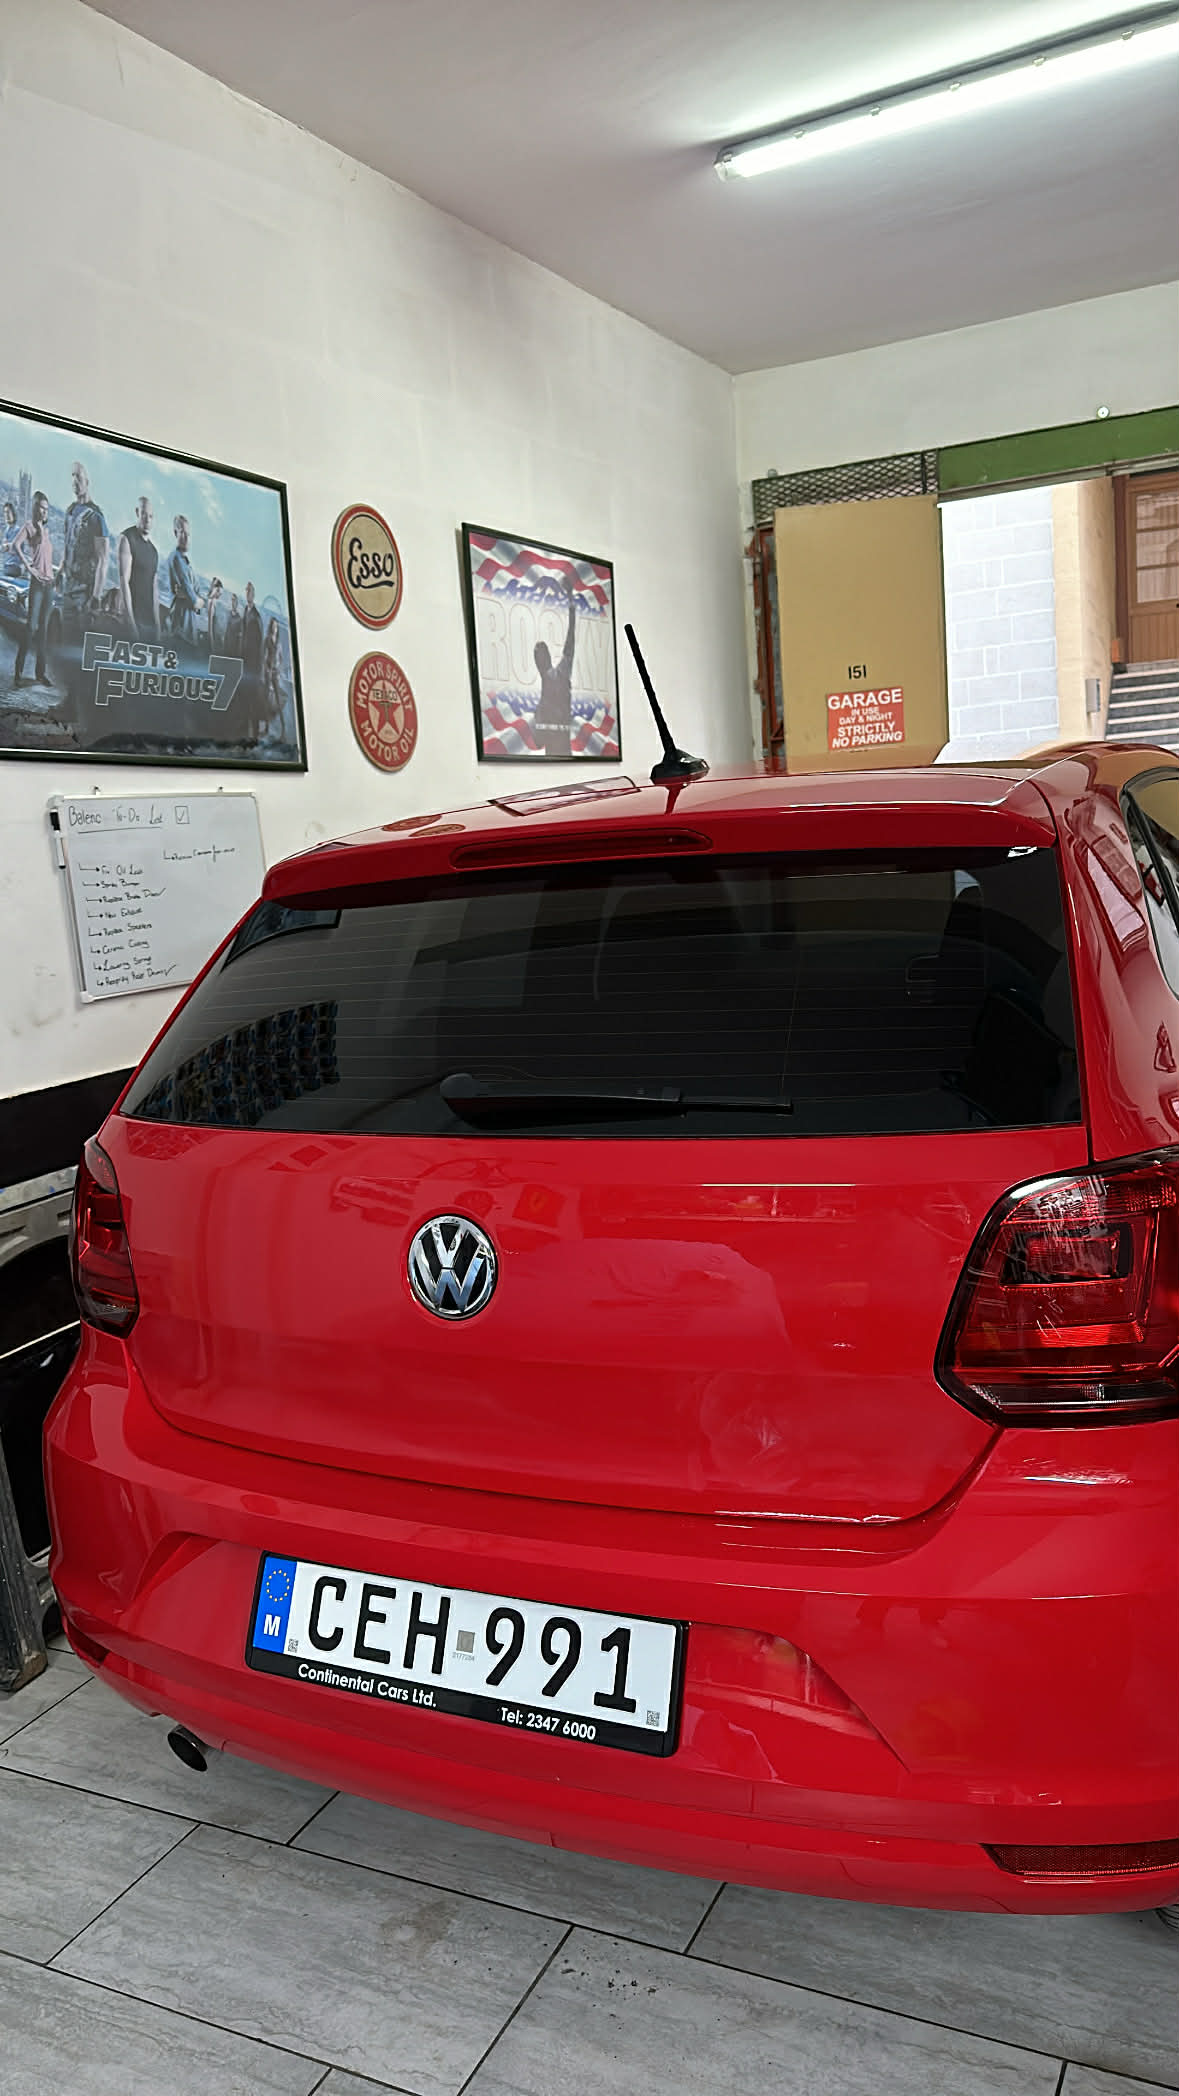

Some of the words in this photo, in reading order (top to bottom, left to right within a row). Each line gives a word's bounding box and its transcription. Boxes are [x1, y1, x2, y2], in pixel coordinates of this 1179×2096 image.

[347, 537, 394, 588] Esso
[163, 650, 178, 671] &
[848, 664, 867, 679] 151
[208, 655, 244, 711] 7
[357, 660, 384, 709] MOTOR
[386, 663, 413, 712] SPIRIT
[828, 688, 902, 710] GARAGE
[851, 708, 860, 716] IN
[862, 706, 880, 716] USE
[838, 721, 895, 737] STRICTLY
[839, 717, 856, 725] DAY
[858, 715, 865, 723] &
[866, 711, 893, 722] NIGHT
[361, 719, 400, 761] MOTOR
[400, 728, 414, 753] OIL
[832, 737, 849, 748] NO
[851, 731, 903, 746] PARKING
[263, 1613, 280, 1637] M
[308, 1576, 451, 1675] CEH
[485, 1607, 637, 1714] 991
[298, 1664, 374, 1693] Continental
[377, 1682, 408, 1700] Cars
[412, 1688, 437, 1707] Ltd.
[501, 1707, 523, 1725] Tel:
[526, 1713, 560, 1732] 2347
[563, 1721, 597, 1740] 6000
